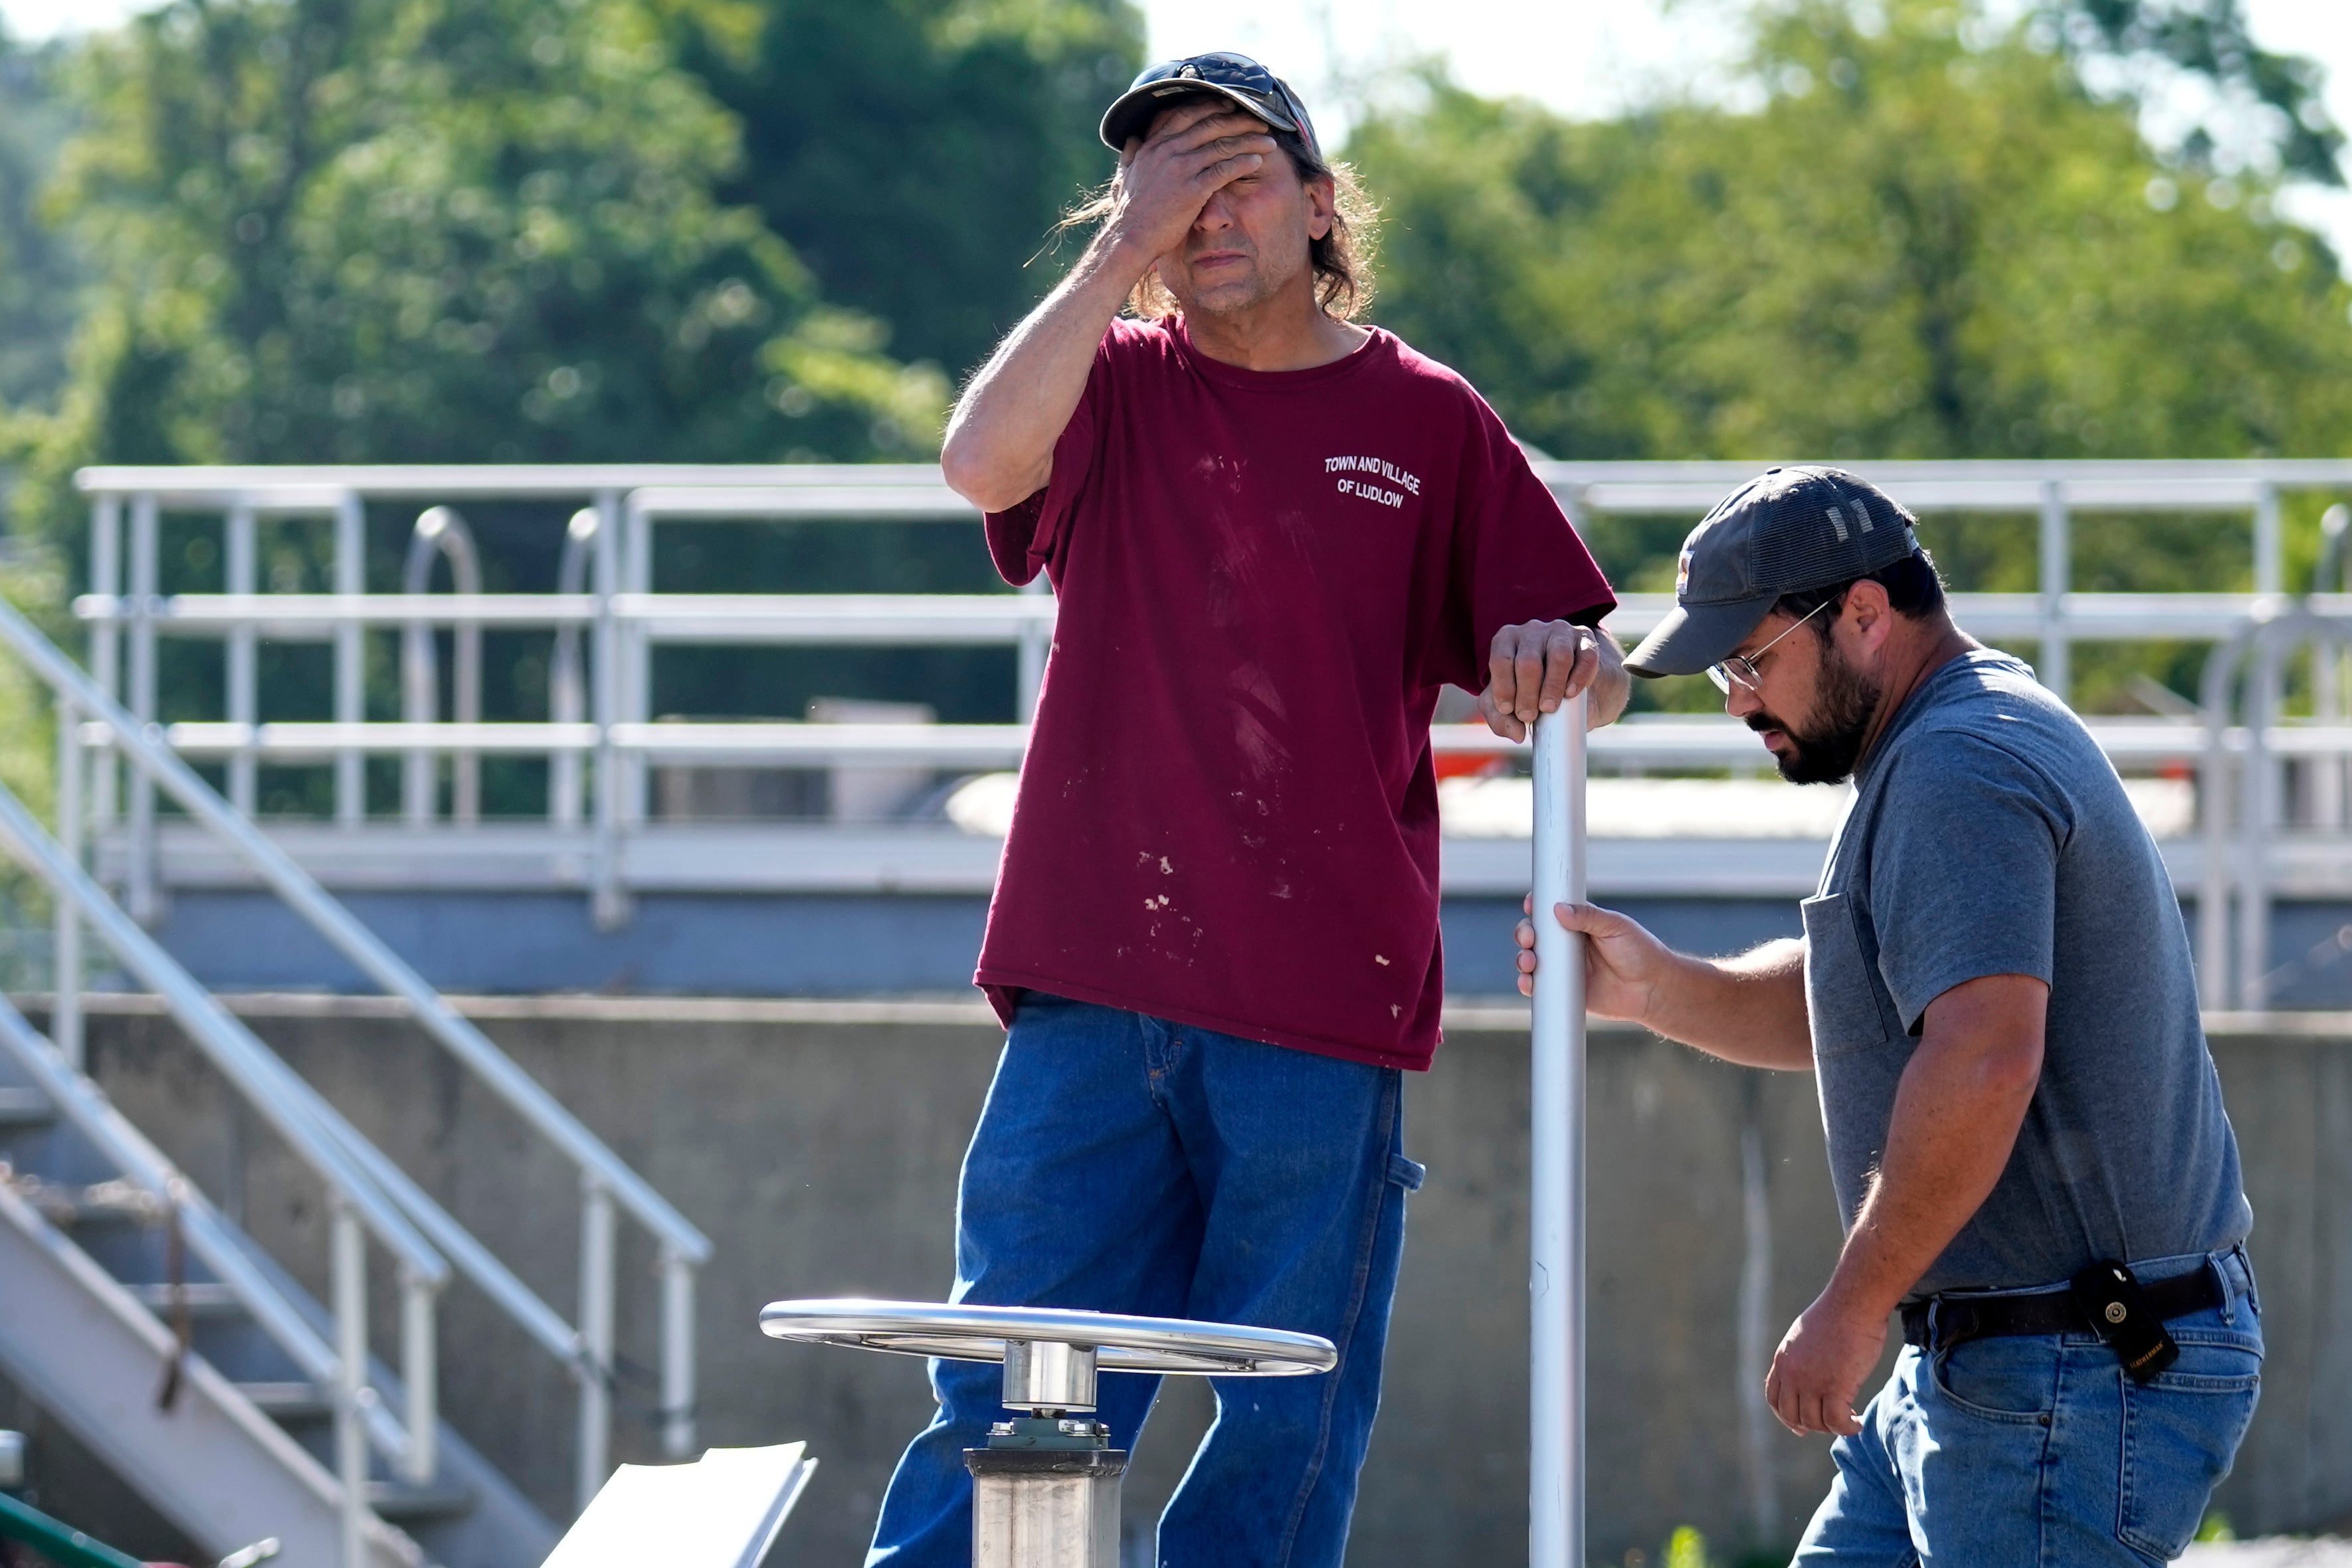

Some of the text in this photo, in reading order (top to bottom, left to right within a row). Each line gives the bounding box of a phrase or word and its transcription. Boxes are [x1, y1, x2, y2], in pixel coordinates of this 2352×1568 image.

[1325, 456, 1421, 496] TOWN AND VILLAGE
[1337, 478, 1404, 508] OF LUDLOW
